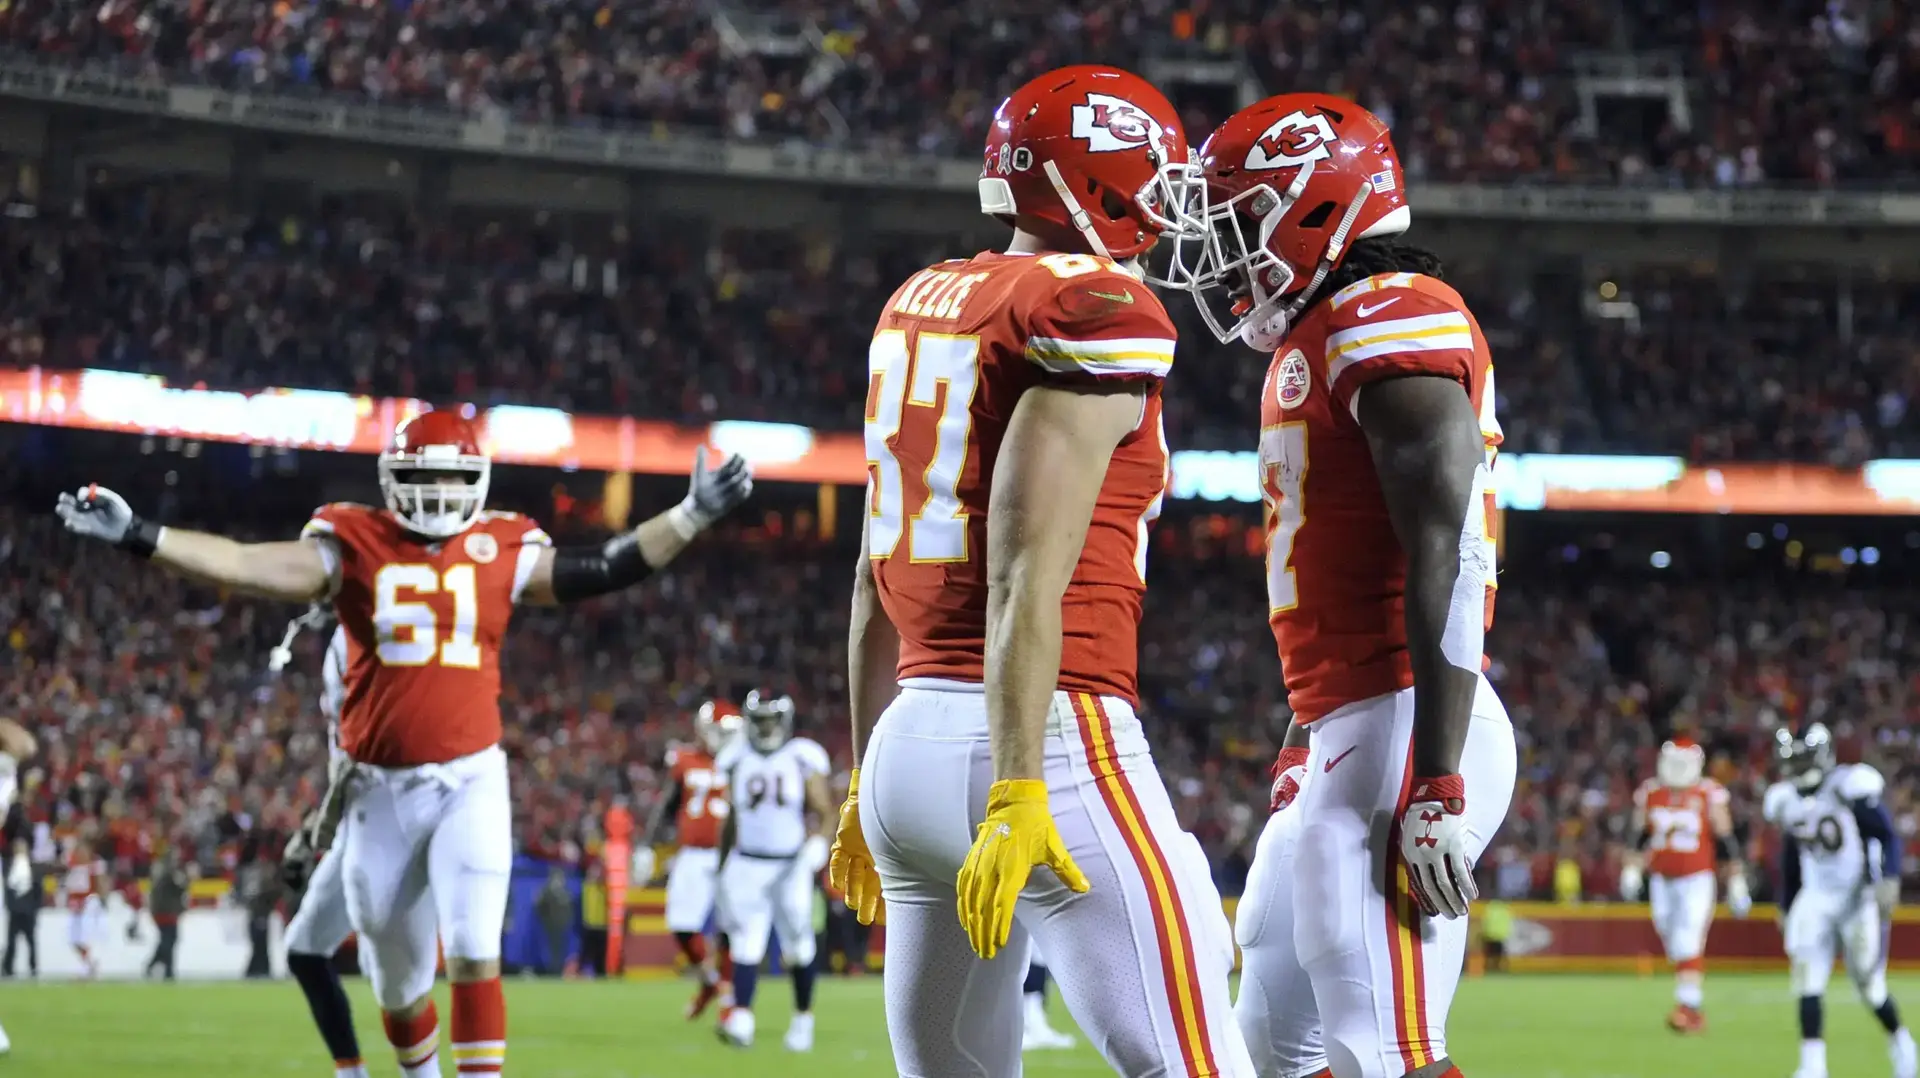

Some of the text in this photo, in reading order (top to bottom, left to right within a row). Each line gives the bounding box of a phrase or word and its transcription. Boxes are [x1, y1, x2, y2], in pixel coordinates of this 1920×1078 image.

[1257, 123, 1325, 162] KC
[893, 268, 990, 321] KELCE
[864, 328, 981, 565] 87
[374, 562, 482, 670] 61
[746, 772, 786, 810] 91
